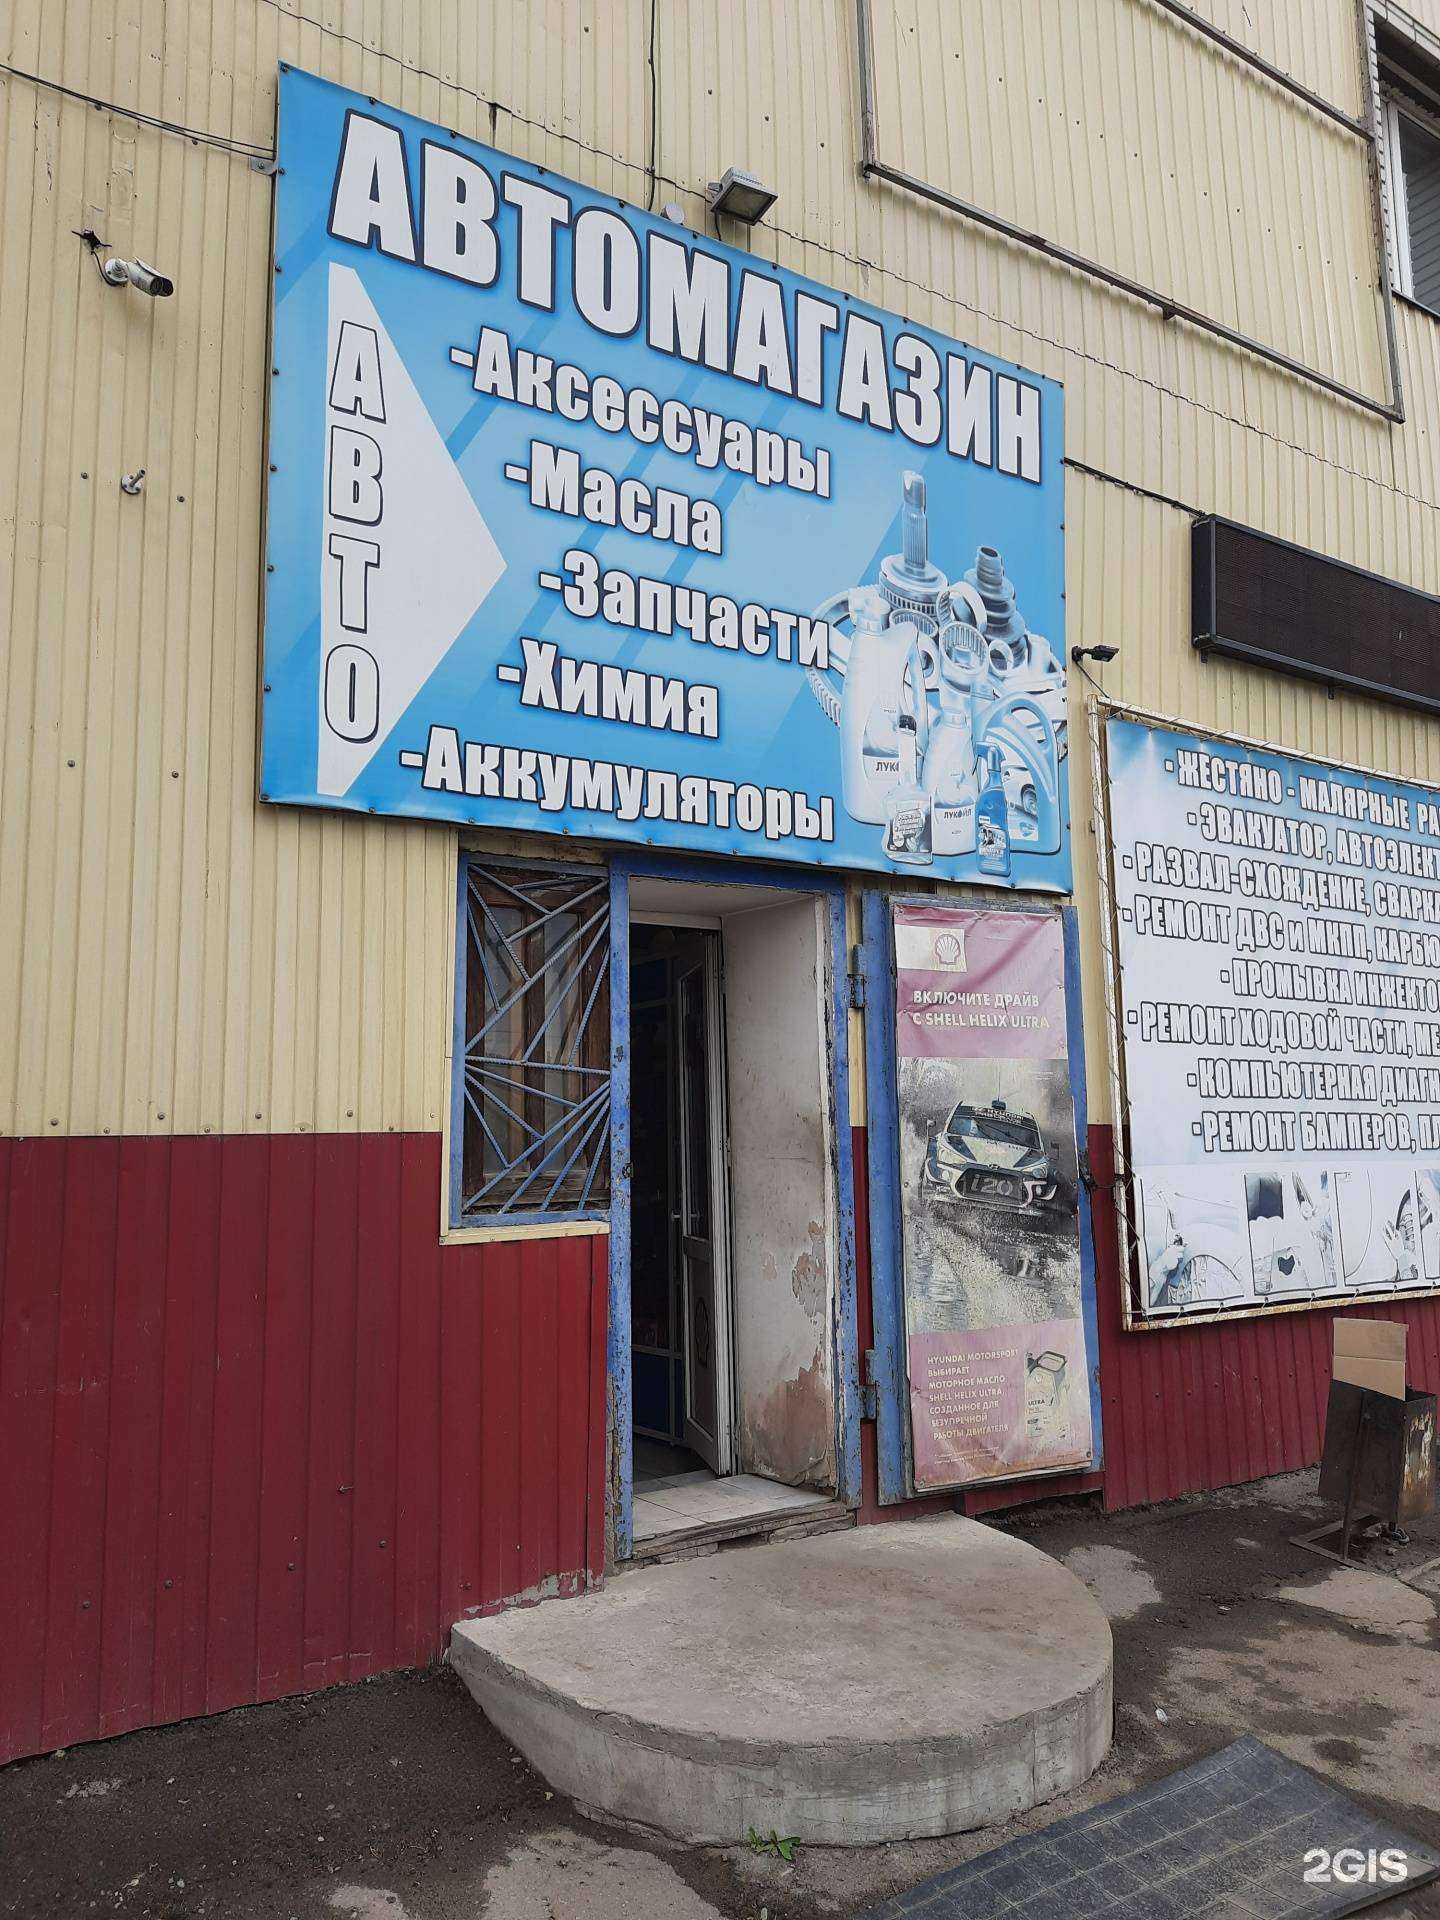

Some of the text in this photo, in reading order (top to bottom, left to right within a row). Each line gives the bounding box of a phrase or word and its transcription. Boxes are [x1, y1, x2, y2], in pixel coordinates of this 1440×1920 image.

[327, 108, 1042, 486] АВТОМАГАЗИН
[449, 325, 831, 499] -Аксессуары
[504, 438, 724, 556] -Масла
[324, 319, 387, 743] АВТО
[539, 548, 830, 669] -Запчасти
[497, 637, 719, 738] -Химия
[399, 724, 834, 841] -Аккумуляторы
[1299, 776, 1411, 831] МАЛЯРНЫЕ
[1416, 801, 1440, 837] РА
[1236, 908, 1285, 952] ДВС
[1307, 917, 1372, 964] МКПП,
[913, 990, 1040, 1009] ВКЛЮЧИТЕ ДРАЙВ
[1354, 971, 1440, 1013] ИНЖЕКТО
[925, 1012, 966, 1027] SHELL
[969, 1013, 1007, 1028] HELIX
[1011, 1015, 1050, 1029] ULTRA
[1237, 1008, 1343, 1053] ХОДОВОЙ
[1344, 1016, 1413, 1059] ЧАСТИ,
[1302, 1111, 1416, 1154] БАМПЕРОВ,
[927, 1349, 1018, 1365] HYUNDAI MOTORSPORT
[928, 1366, 970, 1377] ВЫБИРАЕТ
[928, 1375, 1006, 1390] МОТОРНОЕ МАСЛО
[929, 1392, 953, 1402] SHELL
[954, 1390, 976, 1400] HELIX
[929, 1402, 981, 1415] СОЗДАННОЕ
[931, 1412, 988, 1427] БЕЗУПРЕЧНОЙ
[933, 1423, 1009, 1440] РАБОТЫ ДВИГАТЕЛЯ
